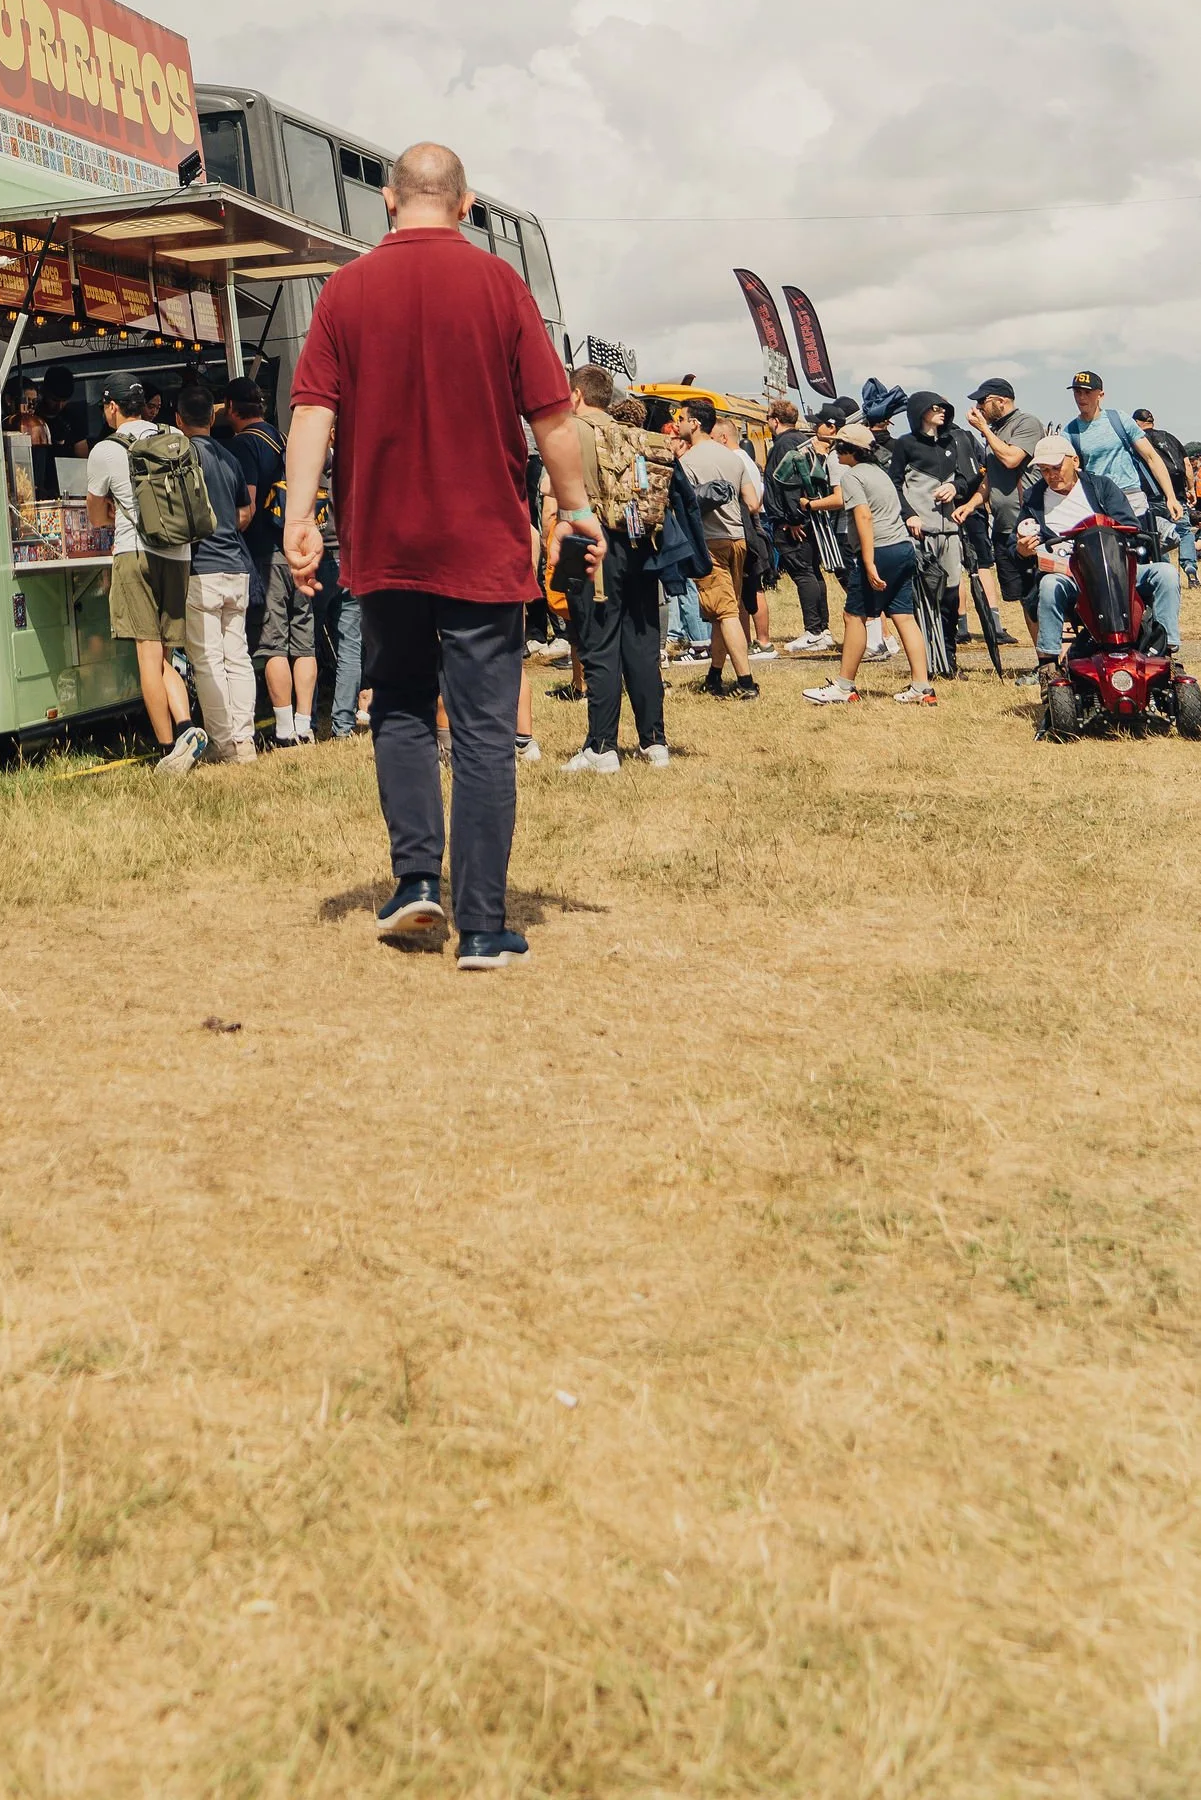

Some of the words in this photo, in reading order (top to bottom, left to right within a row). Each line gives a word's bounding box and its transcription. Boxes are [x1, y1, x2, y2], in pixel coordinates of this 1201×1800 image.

[84, 284, 117, 305] BURRITO
[122, 288, 150, 306] BURRITO
[757, 303, 779, 350] COFFEE
[796, 309, 823, 374] BREAKFAST
